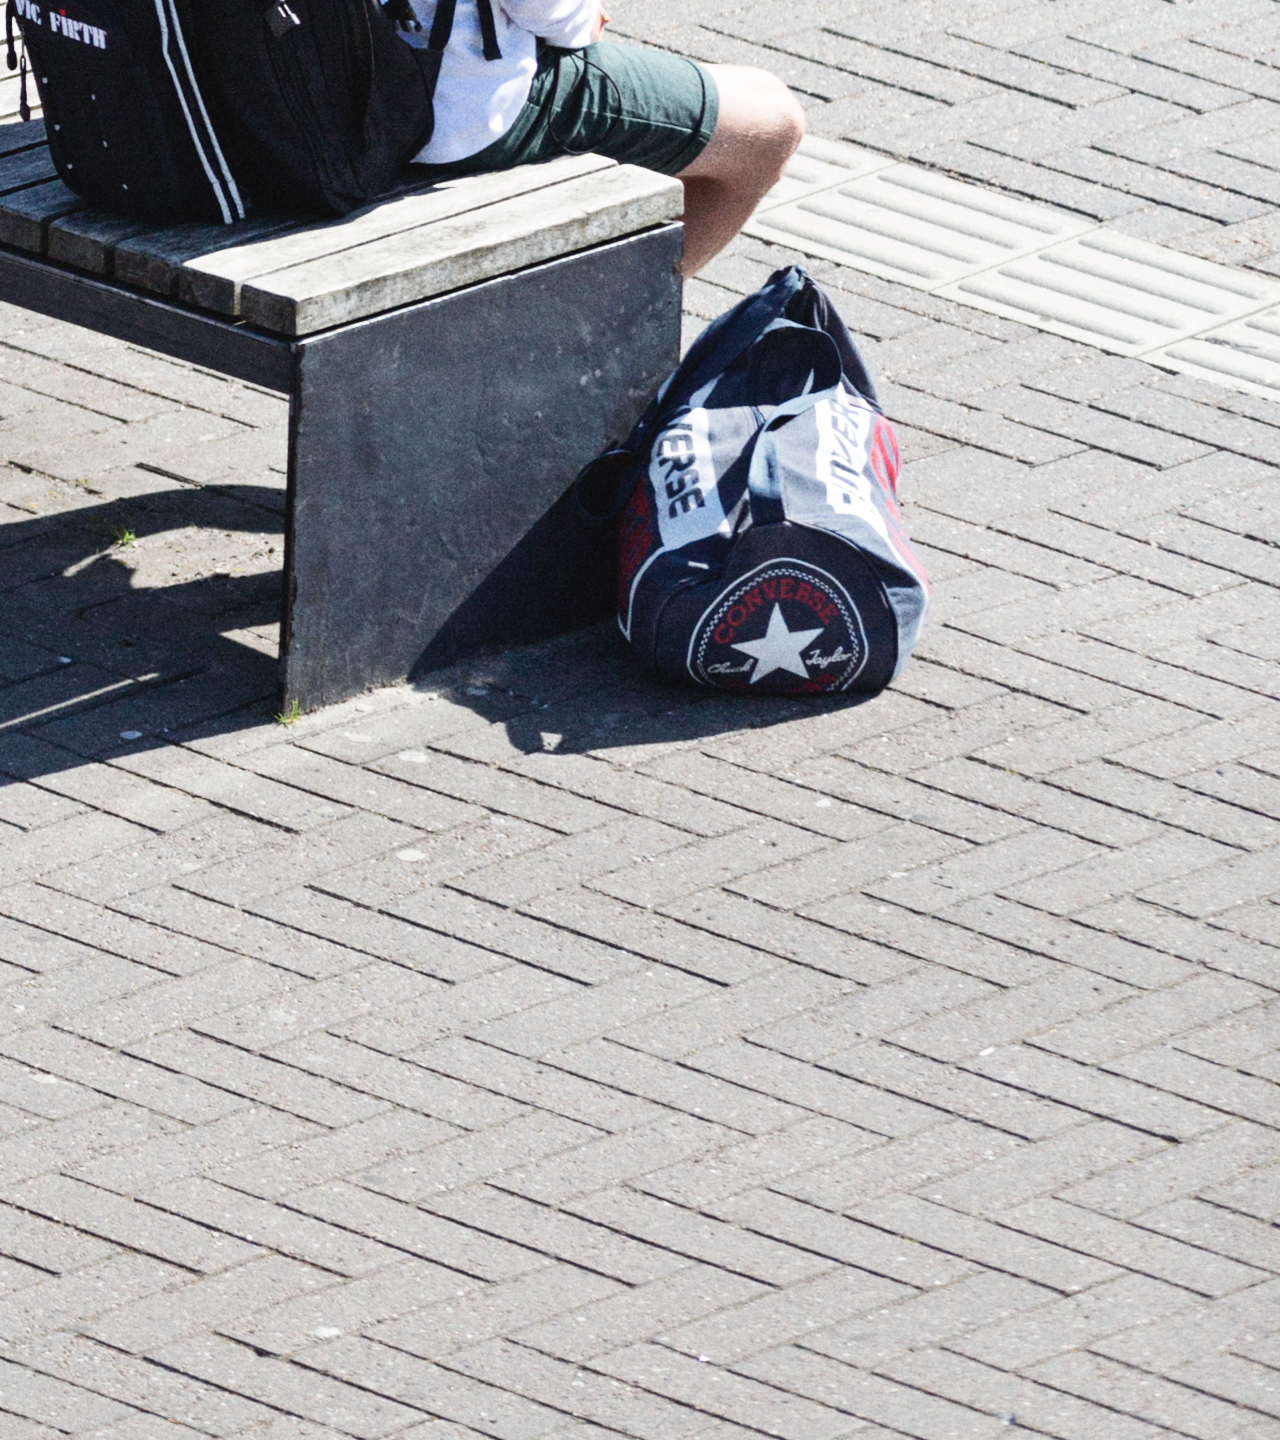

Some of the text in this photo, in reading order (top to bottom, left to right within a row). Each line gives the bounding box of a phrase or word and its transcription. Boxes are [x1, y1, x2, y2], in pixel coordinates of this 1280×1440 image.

[49, 8, 108, 51] FIRTH
[713, 577, 839, 645] CONVERSE
[805, 645, 853, 670] Taylor
